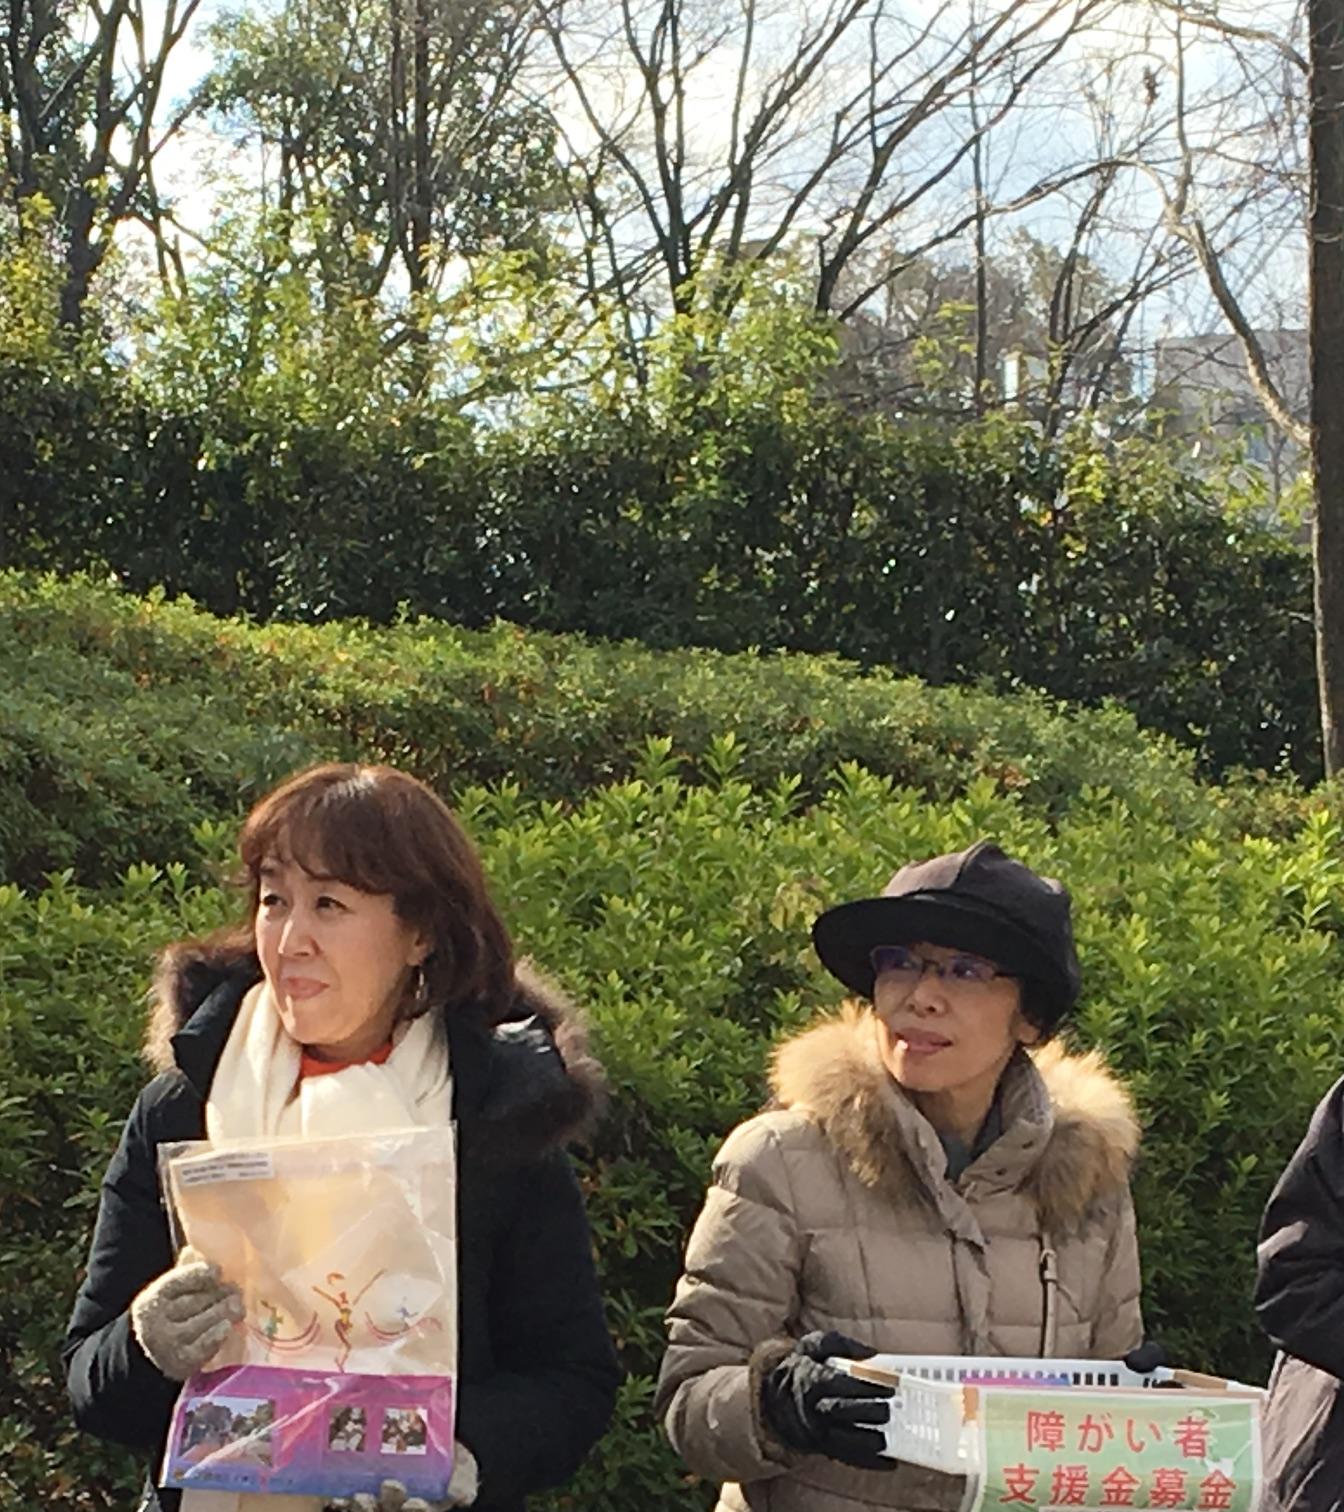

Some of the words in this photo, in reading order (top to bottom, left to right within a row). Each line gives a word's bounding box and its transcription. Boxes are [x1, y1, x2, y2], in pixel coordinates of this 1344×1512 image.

[1026, 1410, 1211, 1458] 障がい者
[1000, 1464, 1237, 1510] 支援金募金
